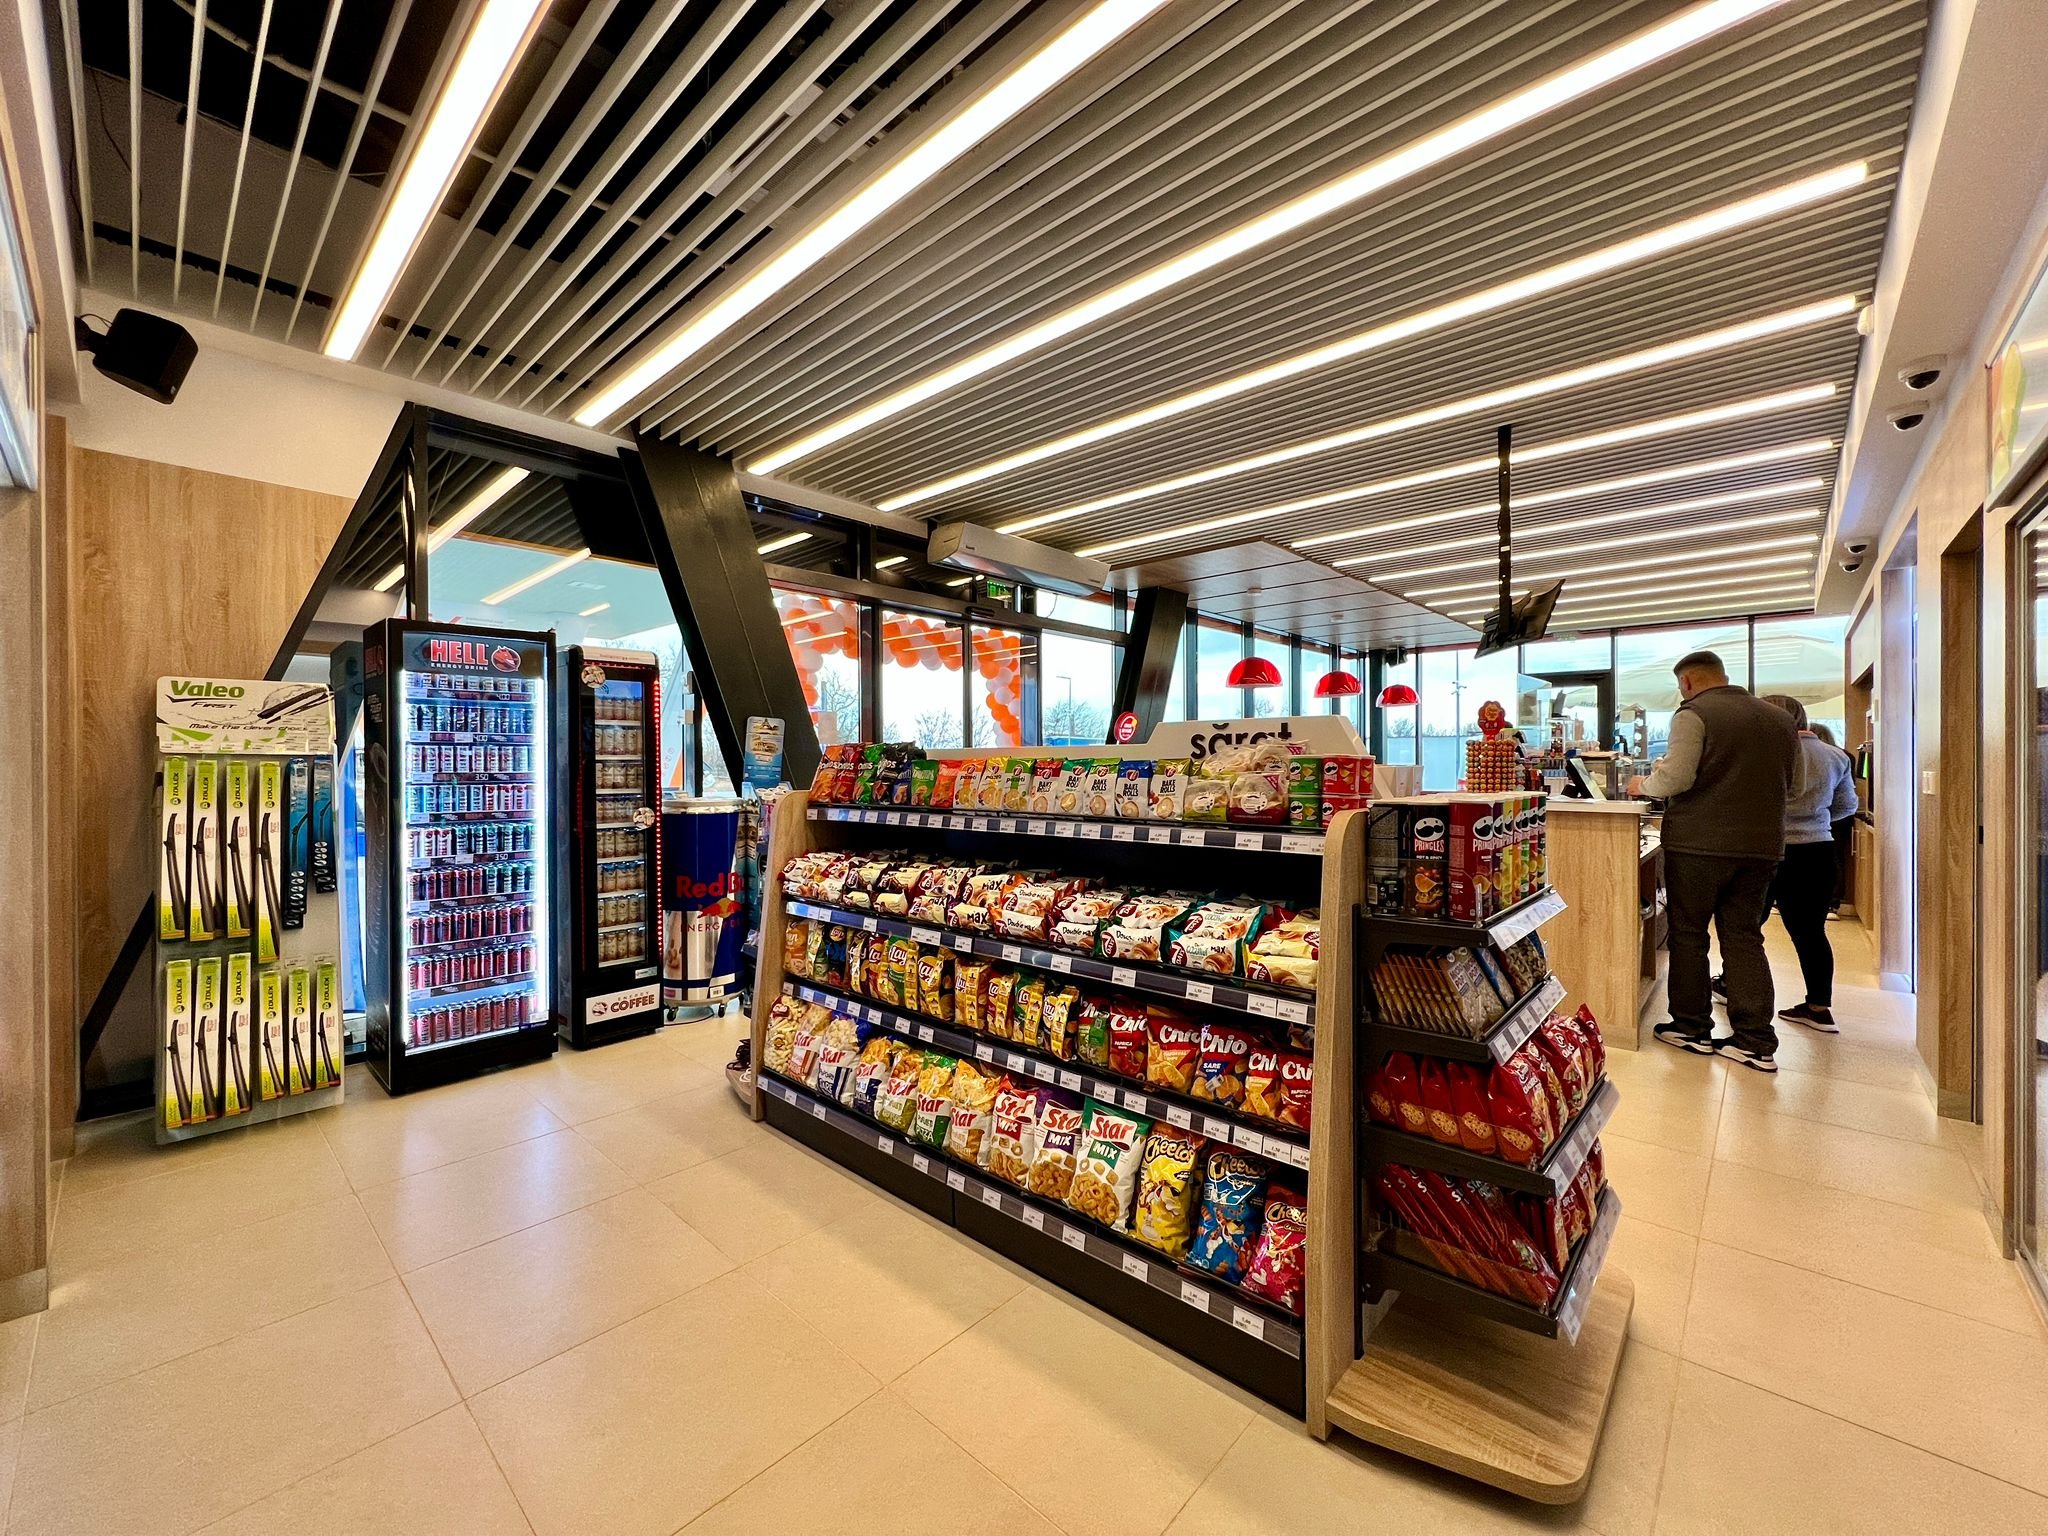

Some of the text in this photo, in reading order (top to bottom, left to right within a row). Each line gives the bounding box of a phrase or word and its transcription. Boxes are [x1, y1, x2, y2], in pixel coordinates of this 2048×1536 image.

[431, 640, 488, 665] HELL
[171, 680, 245, 698] Valeo
[1091, 784, 1107, 792] ROLLS
[1122, 789, 1139, 797] ROLLS
[1160, 785, 1176, 793] ROLLS
[1415, 838, 1445, 853] PRINGLES
[1473, 838, 1493, 852] PRING
[677, 872, 745, 898] Red Bu
[681, 920, 727, 932] NERGY
[889, 946, 908, 966] Lay
[988, 982, 999, 997] La
[1018, 990, 1029, 1004] La
[611, 994, 655, 1013] COFFEE
[1201, 1031, 1248, 1055] Chio
[820, 1046, 846, 1064] Star
[1248, 1052, 1279, 1072] Chi
[1282, 1060, 1313, 1081] Chi
[887, 1078, 918, 1096] Star
[917, 1094, 945, 1113] Star
[951, 1107, 977, 1127] Star
[1043, 1108, 1082, 1130] Sta
[1090, 1116, 1135, 1140] Star
[1048, 1132, 1072, 1146] MIX
[1093, 1141, 1118, 1160] MIX
[1145, 1136, 1195, 1163] Cheetos
[1208, 1152, 1267, 1181] Cheetos
